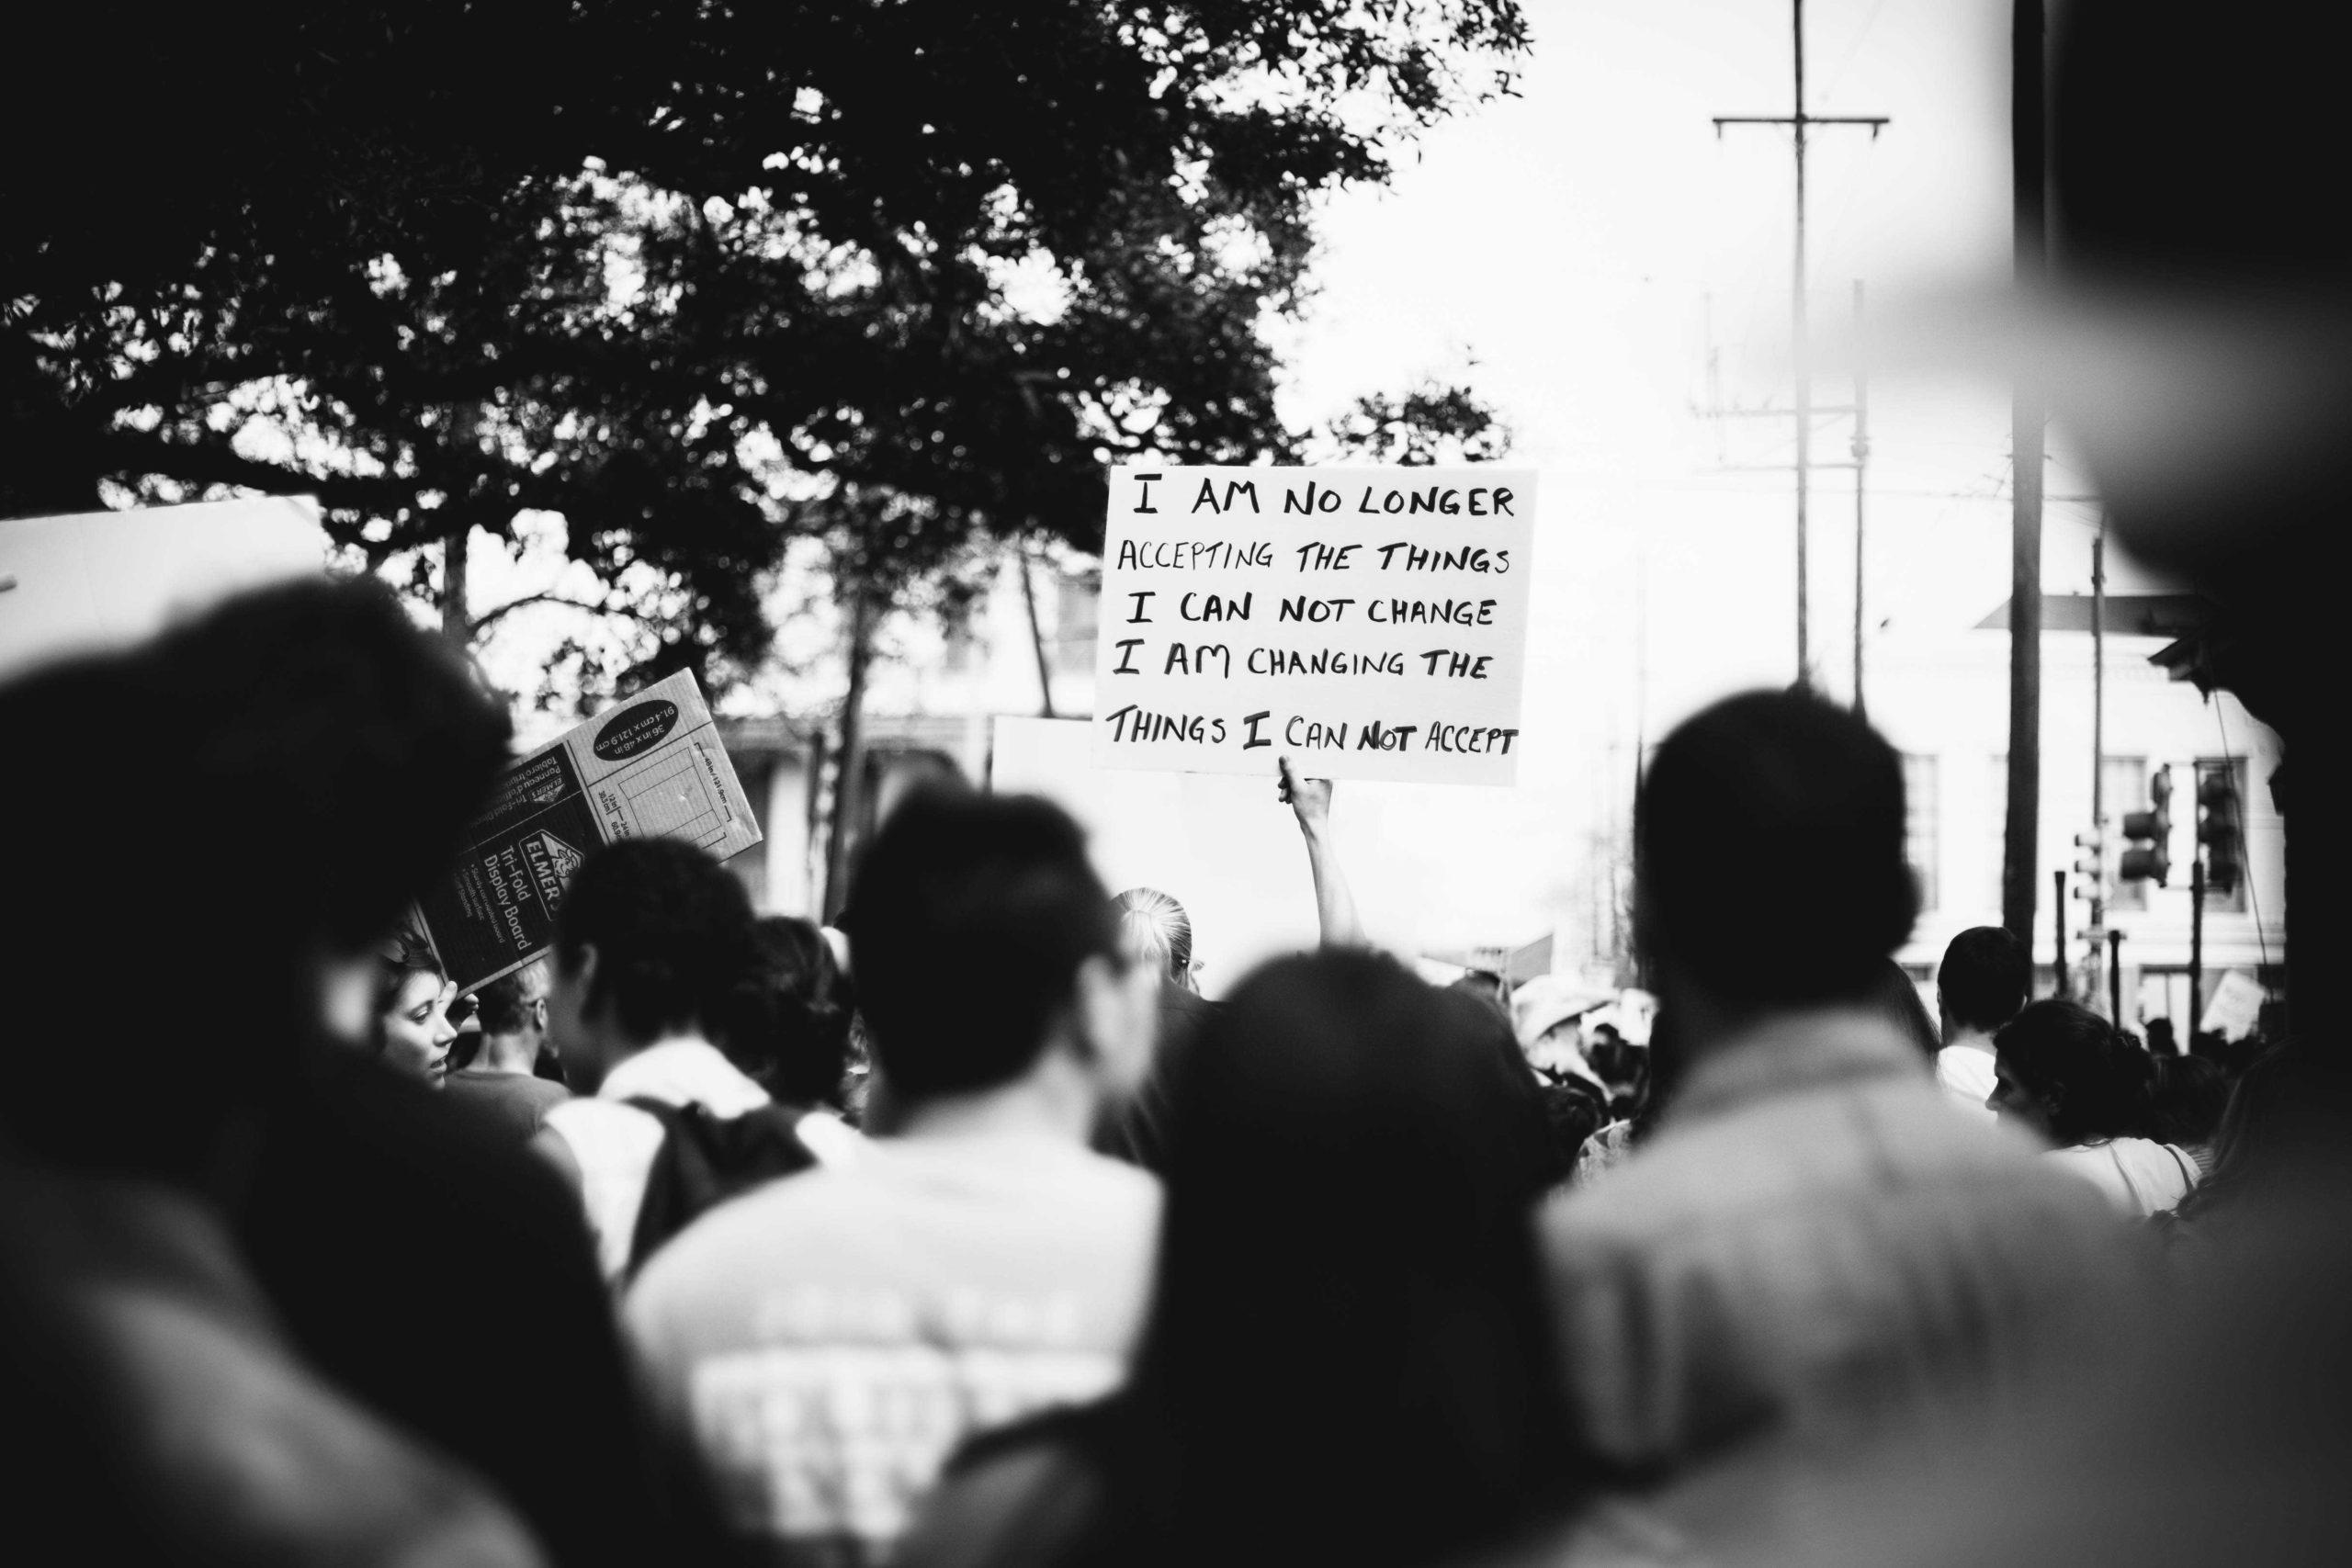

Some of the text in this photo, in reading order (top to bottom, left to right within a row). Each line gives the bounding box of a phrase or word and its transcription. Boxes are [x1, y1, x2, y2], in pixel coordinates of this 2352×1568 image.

[1134, 474, 1514, 516] I AM NO LONGER
[1118, 540, 1509, 573] ACCEPTING THE THINGS
[1126, 592, 1497, 626] I CAN NOT CHANGE
[1114, 638, 1493, 679] I AM CHANGING THE
[640, 716, 655, 728] cm
[655, 705, 674, 723] 91.4
[610, 728, 633, 745] 121.9
[652, 724, 664, 738] 36
[1106, 705, 1519, 754] THINGS I CAN NOT ACCEPT
[596, 740, 610, 751] cm
[624, 740, 636, 751] 48
[523, 765, 561, 789] Panneau
[526, 756, 558, 777] Tablero
[501, 844, 531, 900] Tri-Fold
[484, 854, 532, 950] Display Board
